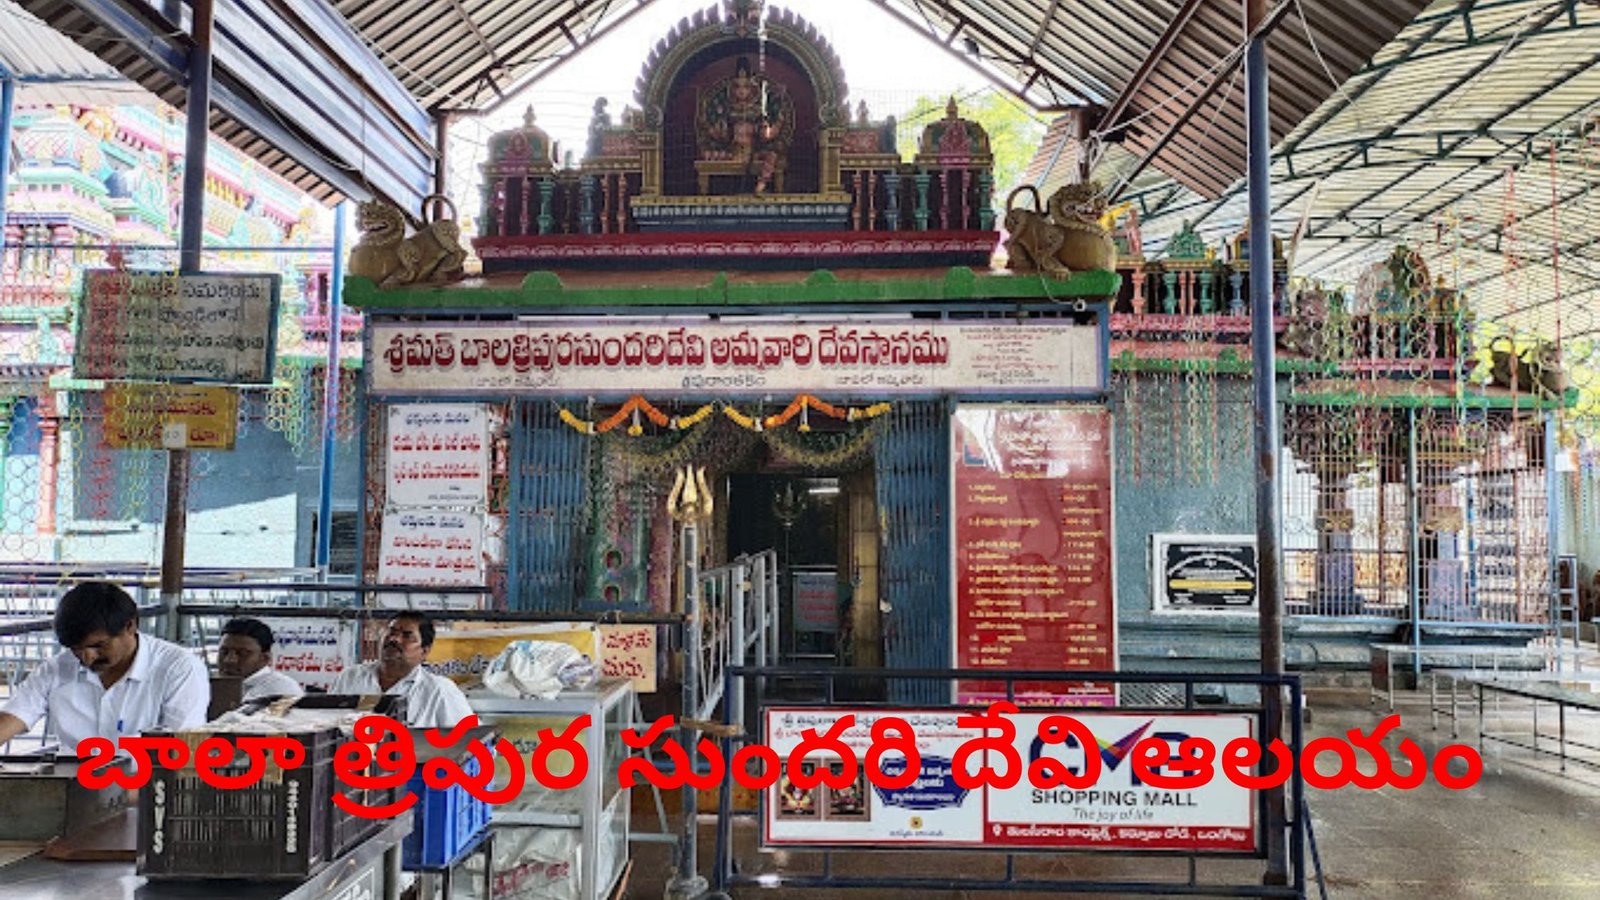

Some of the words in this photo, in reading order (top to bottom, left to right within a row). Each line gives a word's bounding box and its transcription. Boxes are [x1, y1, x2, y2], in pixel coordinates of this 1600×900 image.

[710, 332, 813, 370] అమ్మవారి
[1031, 790, 1138, 807] SHOPPING
[1143, 791, 1198, 807] MALL
[1072, 807, 1096, 820] The
[1098, 808, 1118, 823] joy
[1119, 807, 1134, 821] of
[1134, 807, 1154, 821] life
